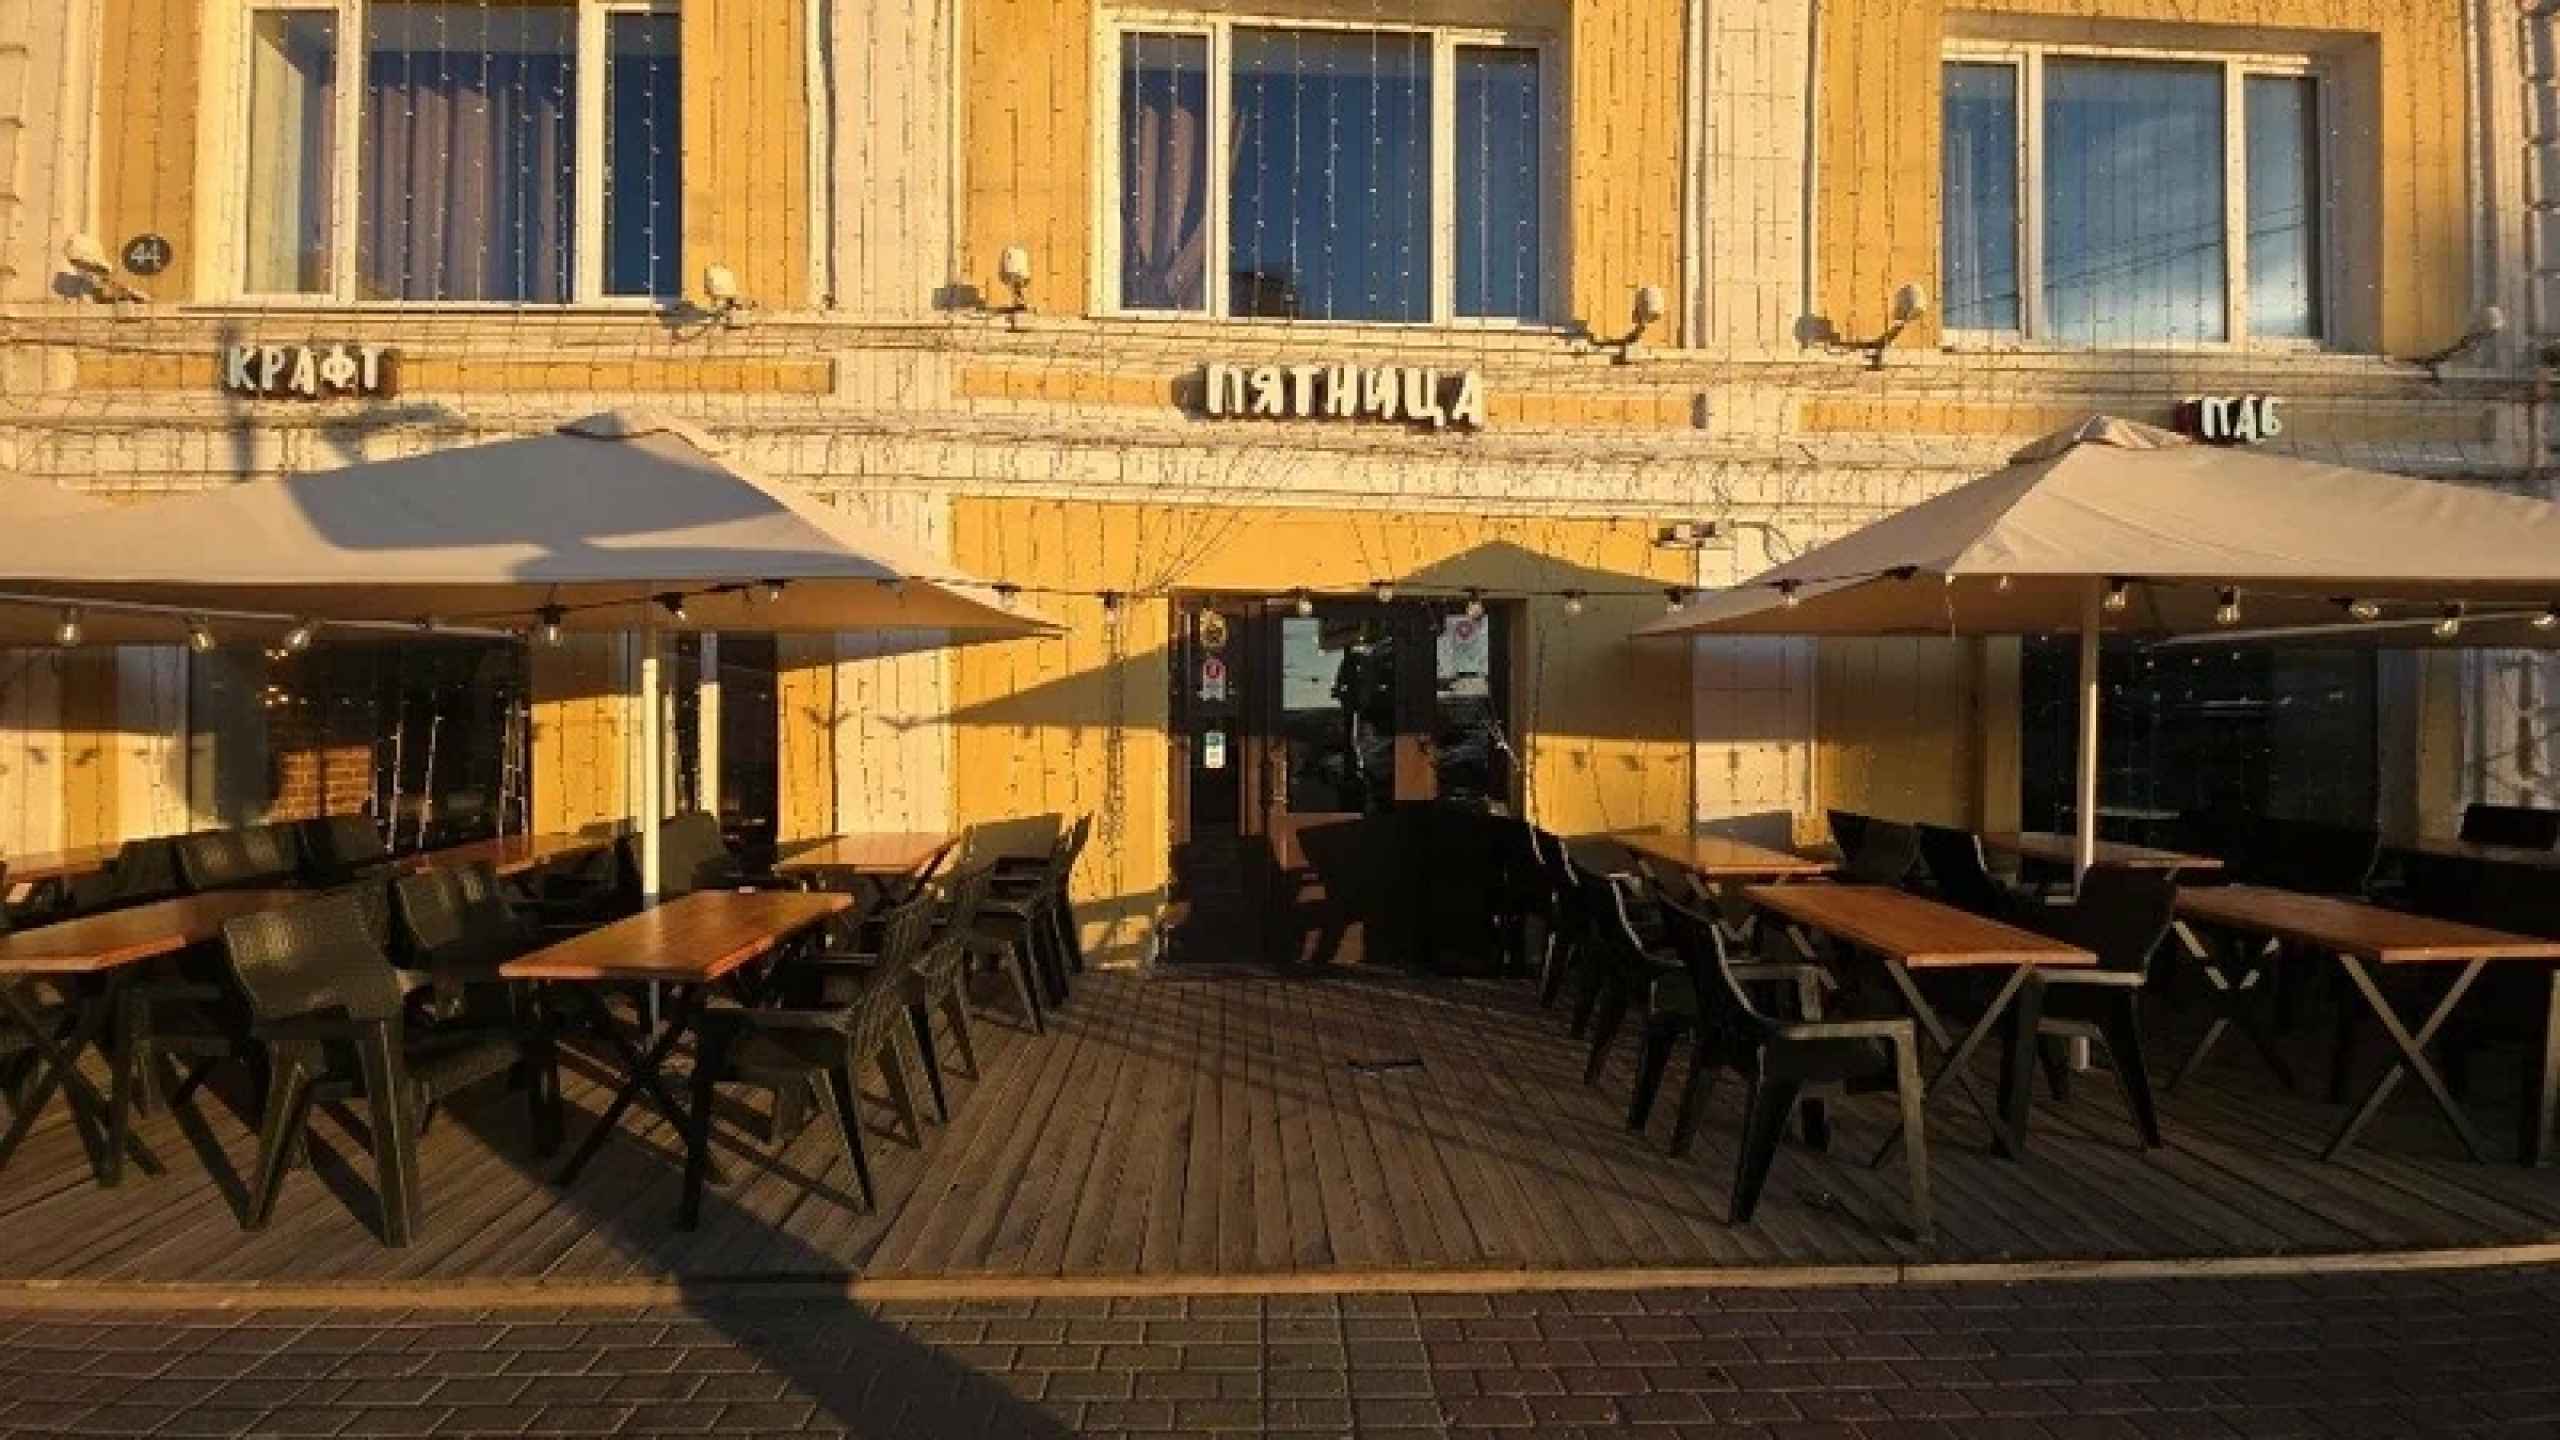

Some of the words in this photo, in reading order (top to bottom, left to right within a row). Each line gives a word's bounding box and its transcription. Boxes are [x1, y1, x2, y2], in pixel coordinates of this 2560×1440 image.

[130, 241, 162, 270] 44
[228, 343, 387, 395] КРАФТ
[1204, 361, 1484, 427] ПЯТНИЦА
[2199, 394, 2285, 442] ПАБ
